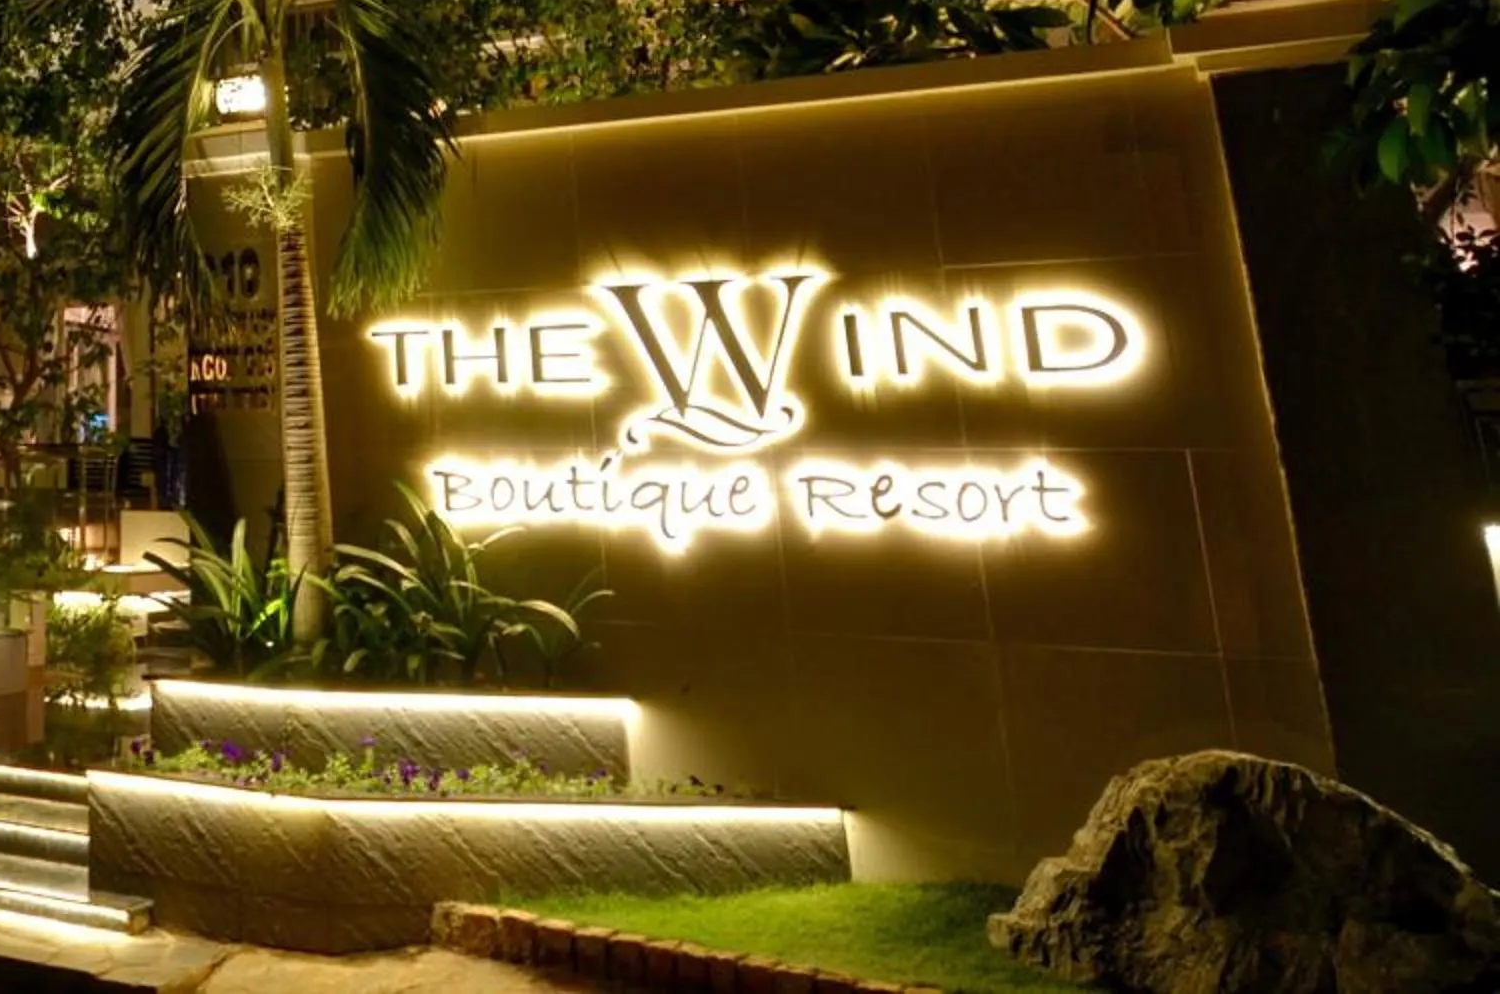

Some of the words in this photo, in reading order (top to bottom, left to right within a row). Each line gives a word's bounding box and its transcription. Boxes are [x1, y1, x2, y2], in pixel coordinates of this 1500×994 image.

[370, 322, 593, 387] THE
[601, 273, 1130, 420] WIND
[431, 456, 758, 540] Boutique
[797, 469, 1072, 524] Resort
